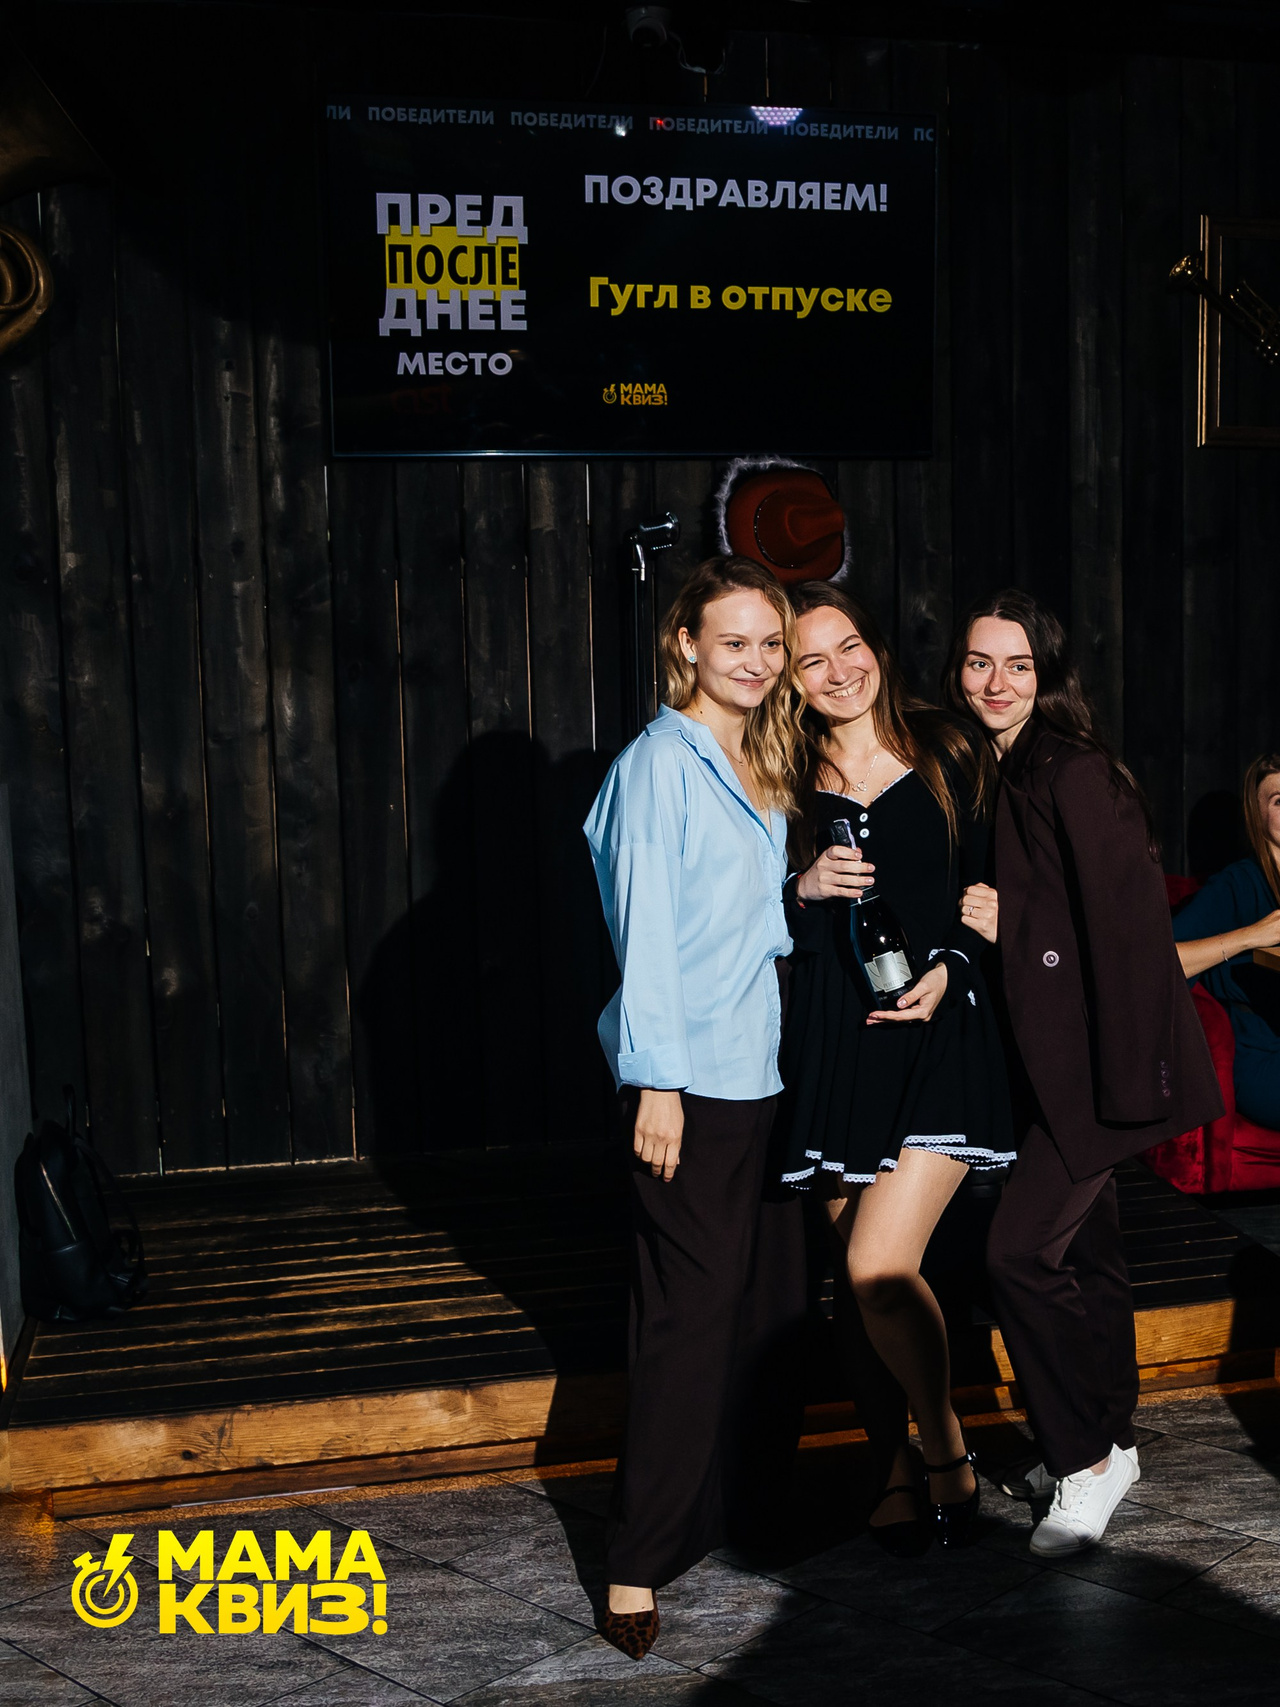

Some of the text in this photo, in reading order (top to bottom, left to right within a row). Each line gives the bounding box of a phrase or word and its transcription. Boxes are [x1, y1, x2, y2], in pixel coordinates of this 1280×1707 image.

[368, 106, 495, 125] ПОБЕДИТЕЛИ
[510, 111, 634, 130] ПОБЕДИТЕЛИ
[649, 116, 768, 136] ПОБЕДИТЕЛИ
[783, 122, 899, 140] ПОБЕДИТЕЛИ
[584, 174, 889, 212] ПОЗДРАВЛЯЕМ!
[375, 192, 529, 244] ПРЕД
[388, 244, 518, 286] ПОСЛЕ
[378, 288, 528, 338] ДНЕЕ
[589, 275, 893, 320] Гугл в отпуске
[396, 351, 513, 376] МЕСТО
[619, 382, 667, 395] МАМА
[619, 394, 669, 406] КВИЗ!
